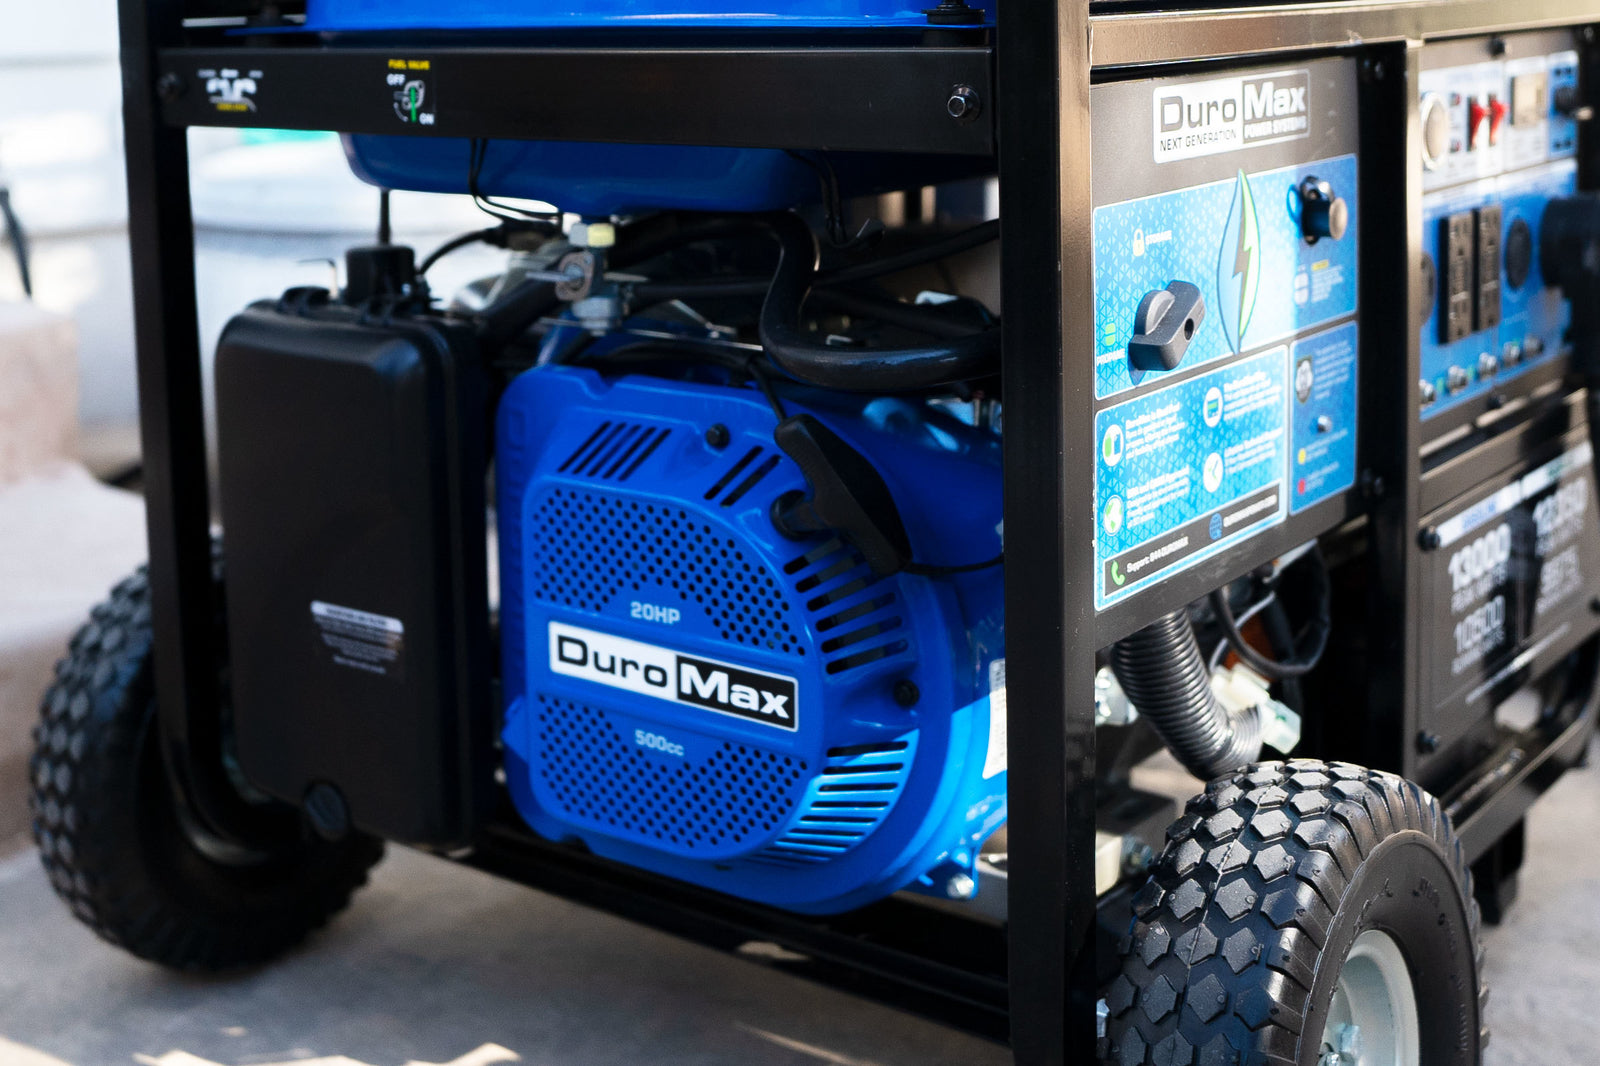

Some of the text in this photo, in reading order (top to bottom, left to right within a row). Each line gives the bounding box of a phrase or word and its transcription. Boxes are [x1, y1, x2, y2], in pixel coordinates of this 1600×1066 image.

[386, 73, 406, 86] OFF
[419, 112, 435, 125] ON
[1160, 129, 1237, 152] NEXT GENERATION
[1448, 522, 1512, 593] 13000
[630, 601, 681, 625] 20HP
[635, 729, 684, 757] 500cc
